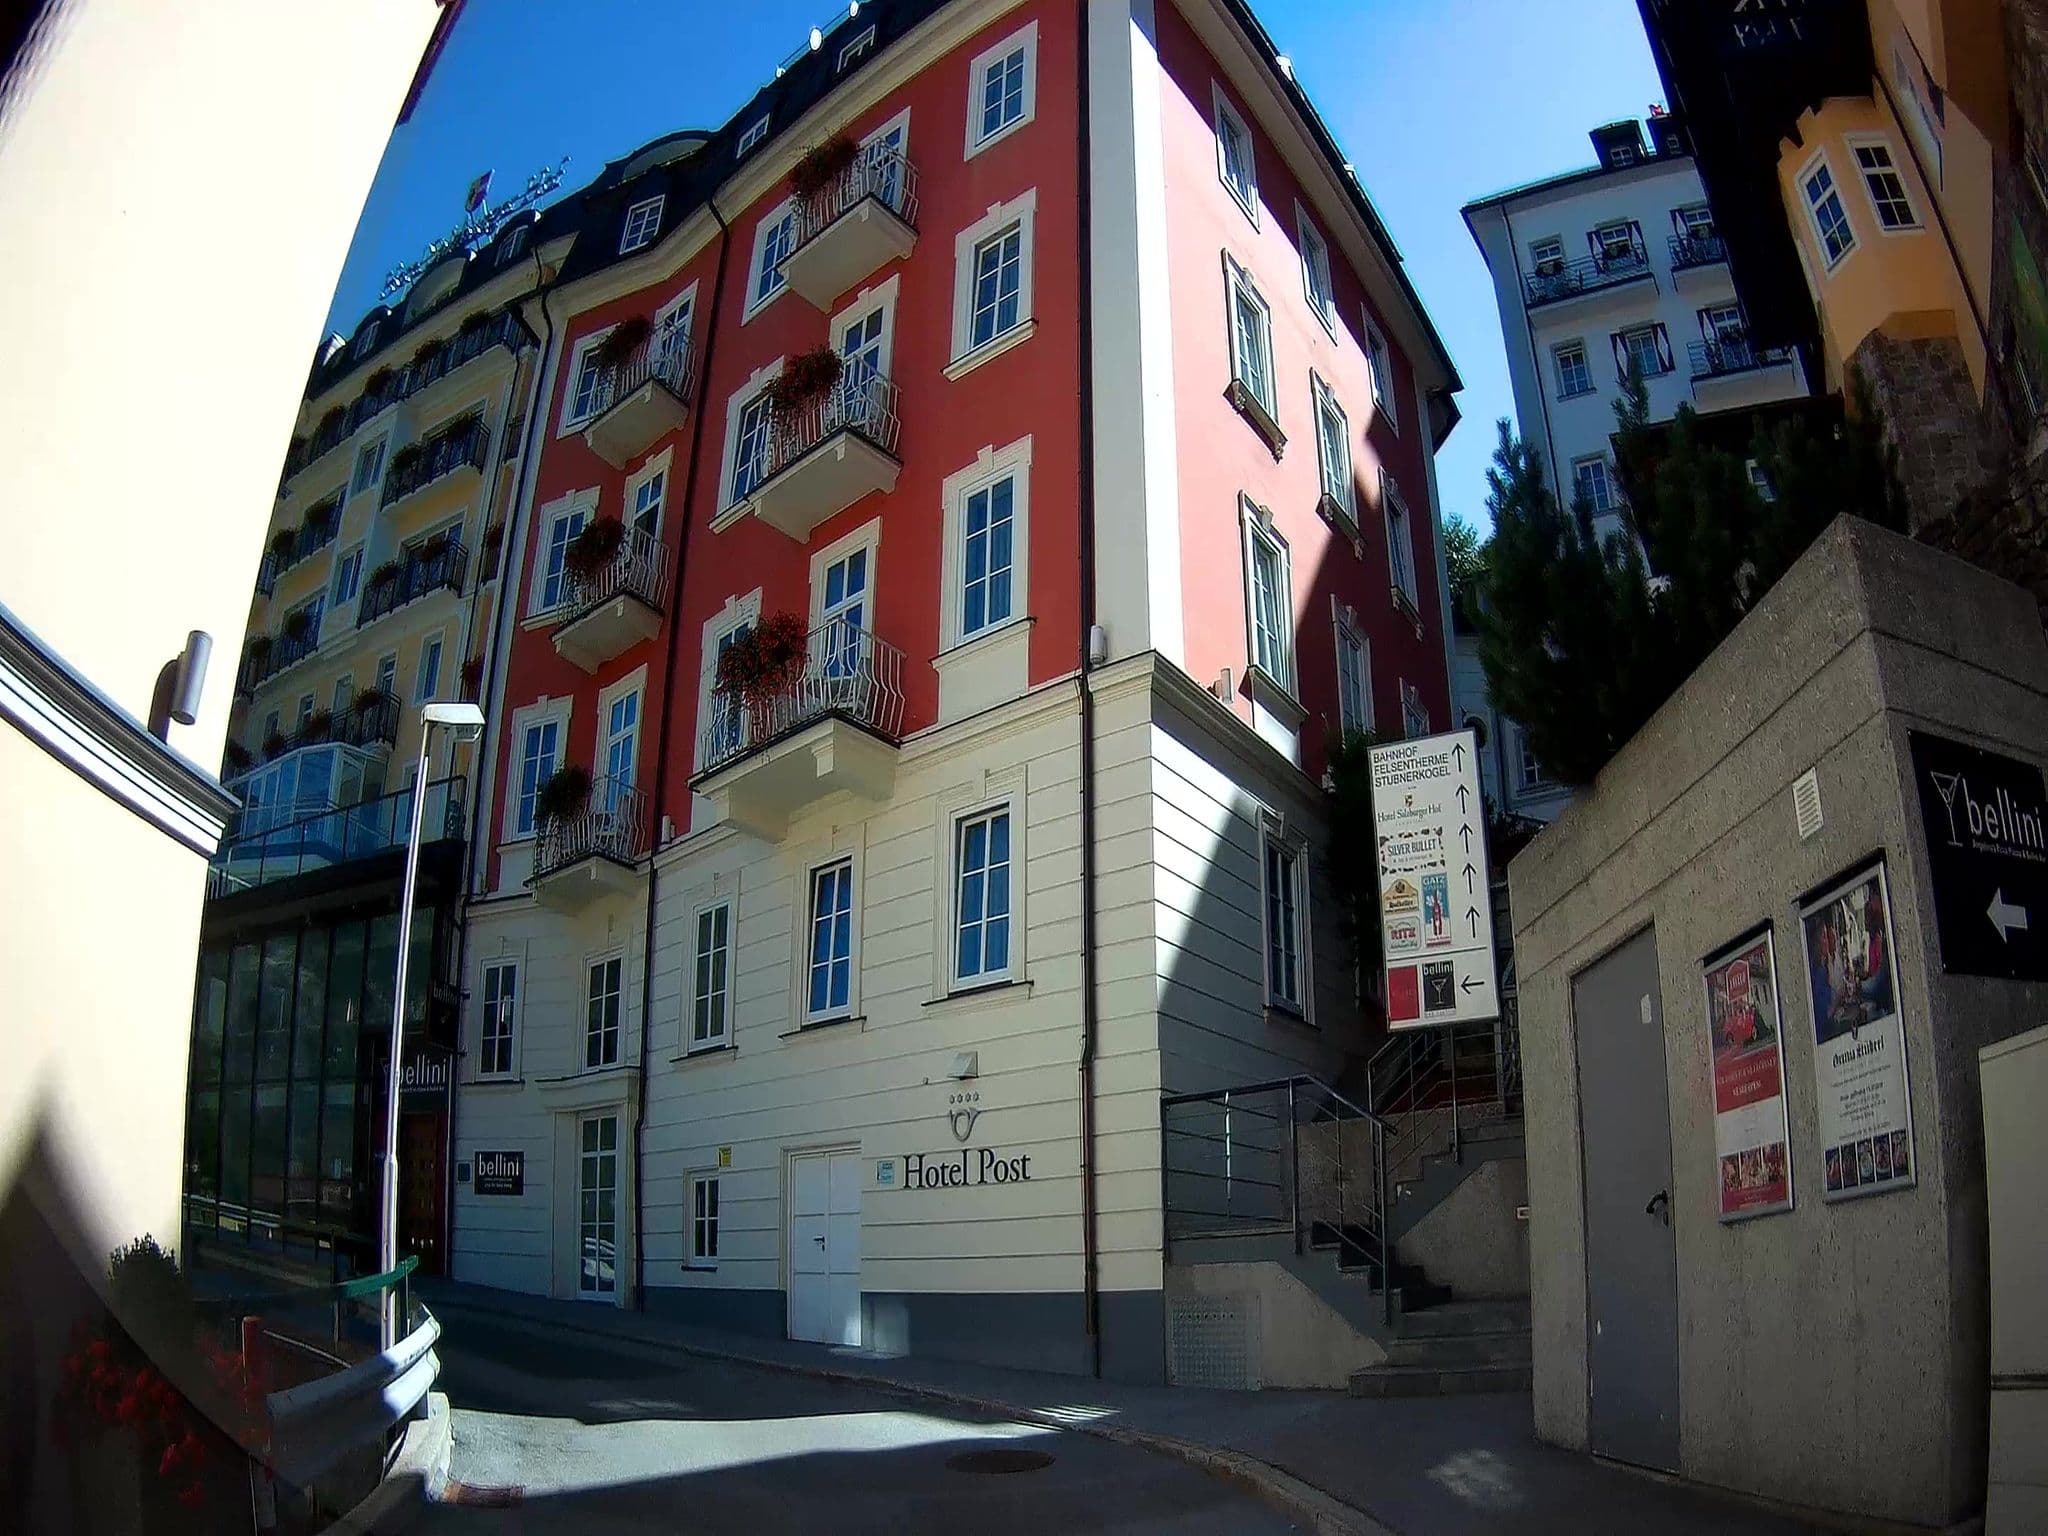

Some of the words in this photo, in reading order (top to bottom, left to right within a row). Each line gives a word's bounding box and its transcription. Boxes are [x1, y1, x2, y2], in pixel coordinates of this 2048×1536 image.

[1373, 746, 1418, 763] BAHNHOF
[1374, 753, 1449, 776] FELSENTHERME
[1375, 765, 1450, 788] STUBNERKOGEL
[1962, 778, 2045, 849] bellini
[1388, 842, 1411, 856] SILVER
[1411, 839, 1436, 853] BULLET
[1391, 927, 1416, 940] RITZ
[479, 1152, 519, 1177] bellini
[903, 1149, 970, 1189] Hotel
[978, 1149, 1031, 1186] Post
